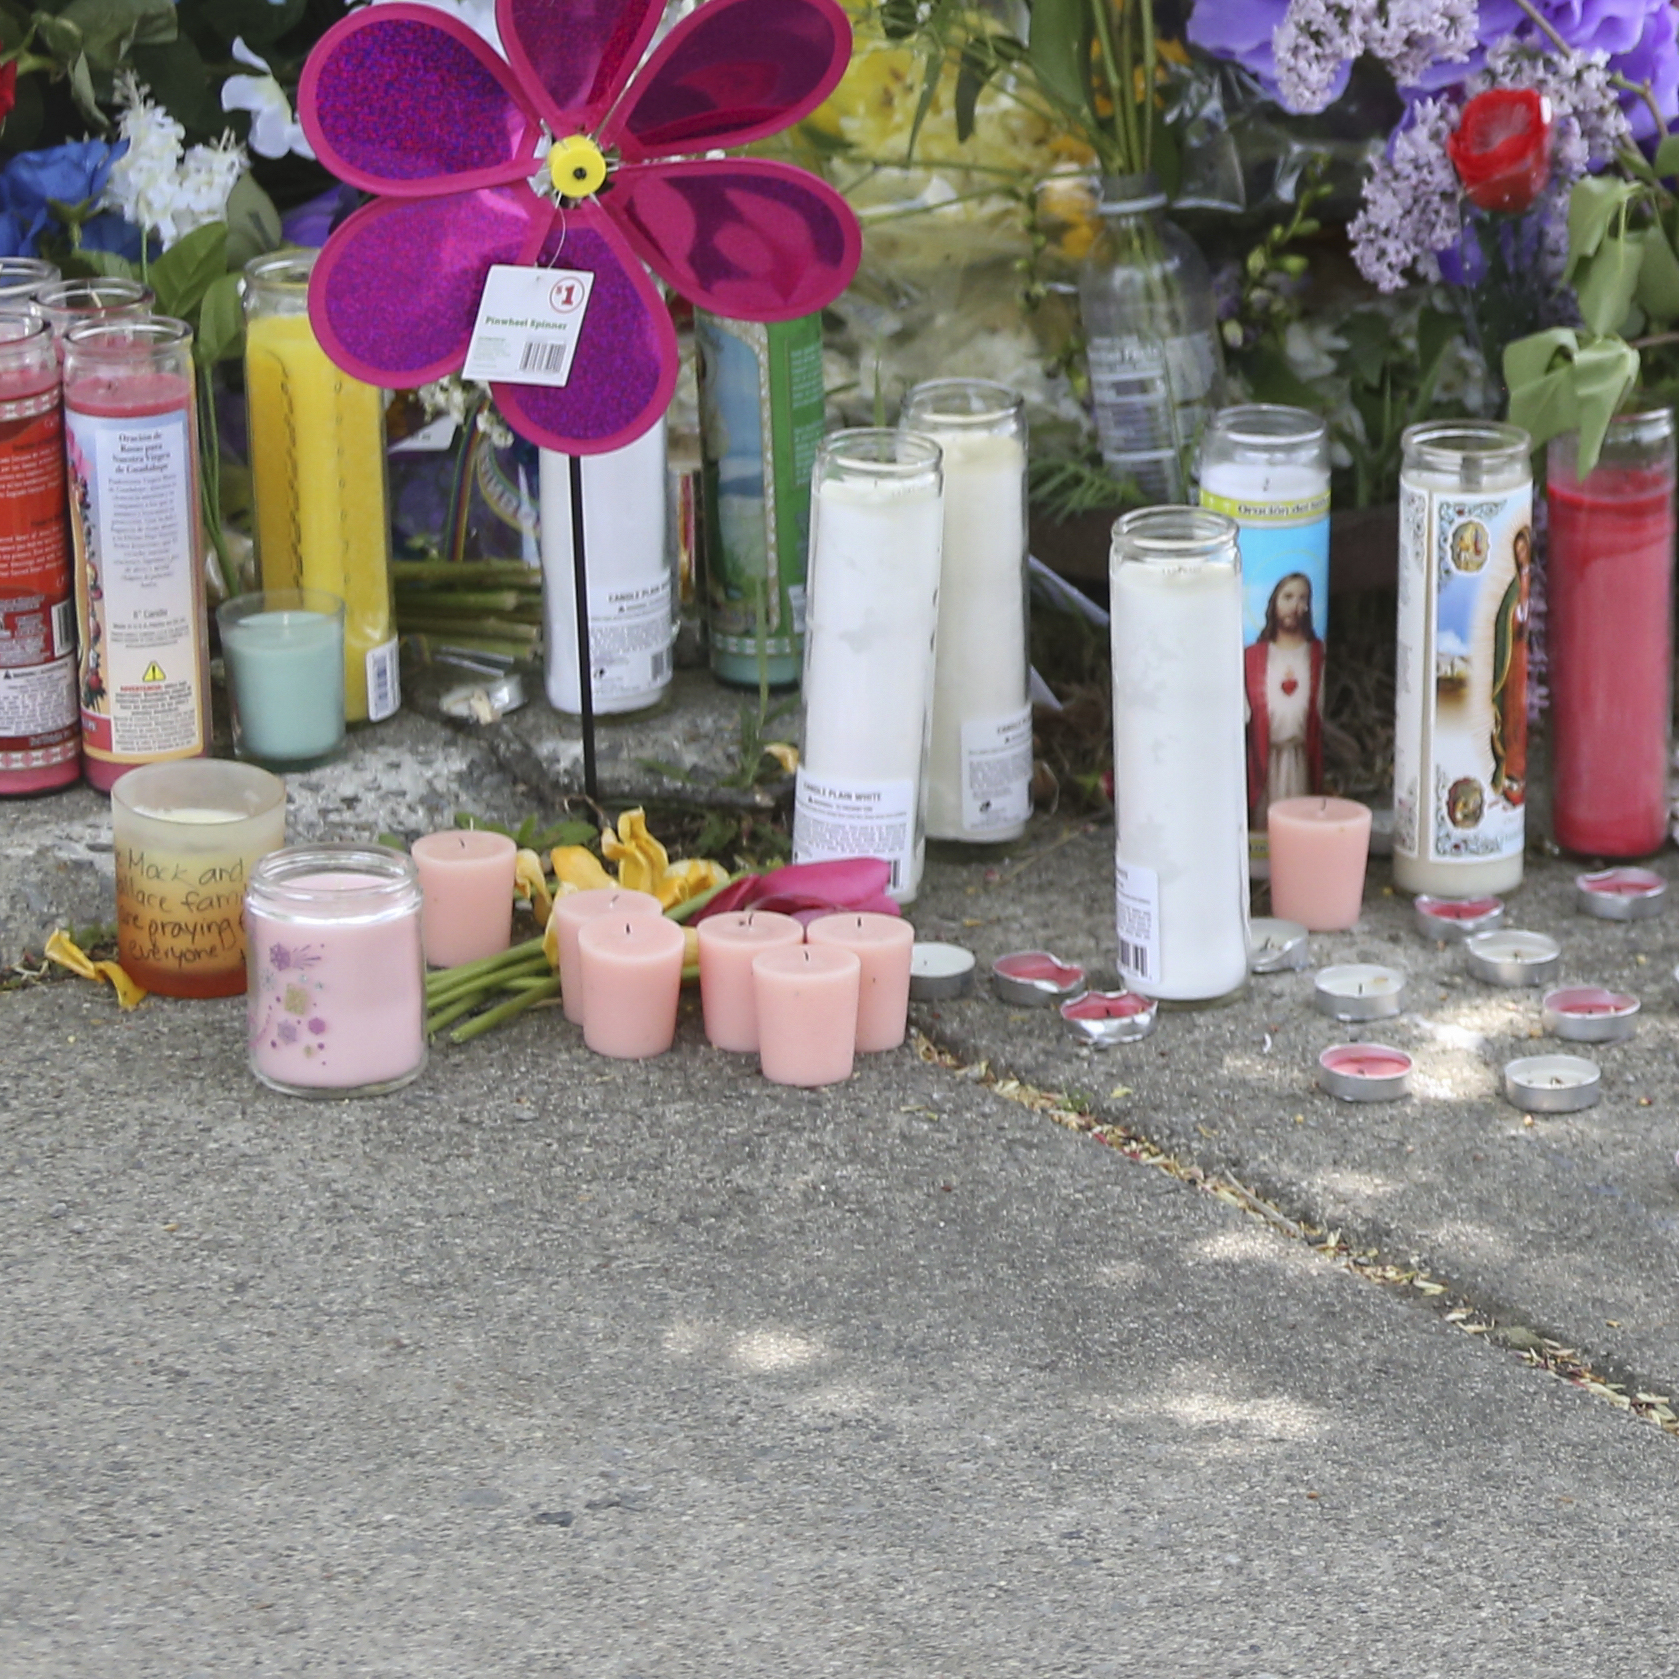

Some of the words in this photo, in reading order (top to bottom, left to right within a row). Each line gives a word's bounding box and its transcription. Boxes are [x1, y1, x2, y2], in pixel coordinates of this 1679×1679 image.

[555, 284, 575, 306] $1
[485, 316, 528, 328] Pinwheel
[530, 319, 568, 331] Spinner
[1238, 503, 1289, 517] Oración
[148, 916, 237, 951] praying
